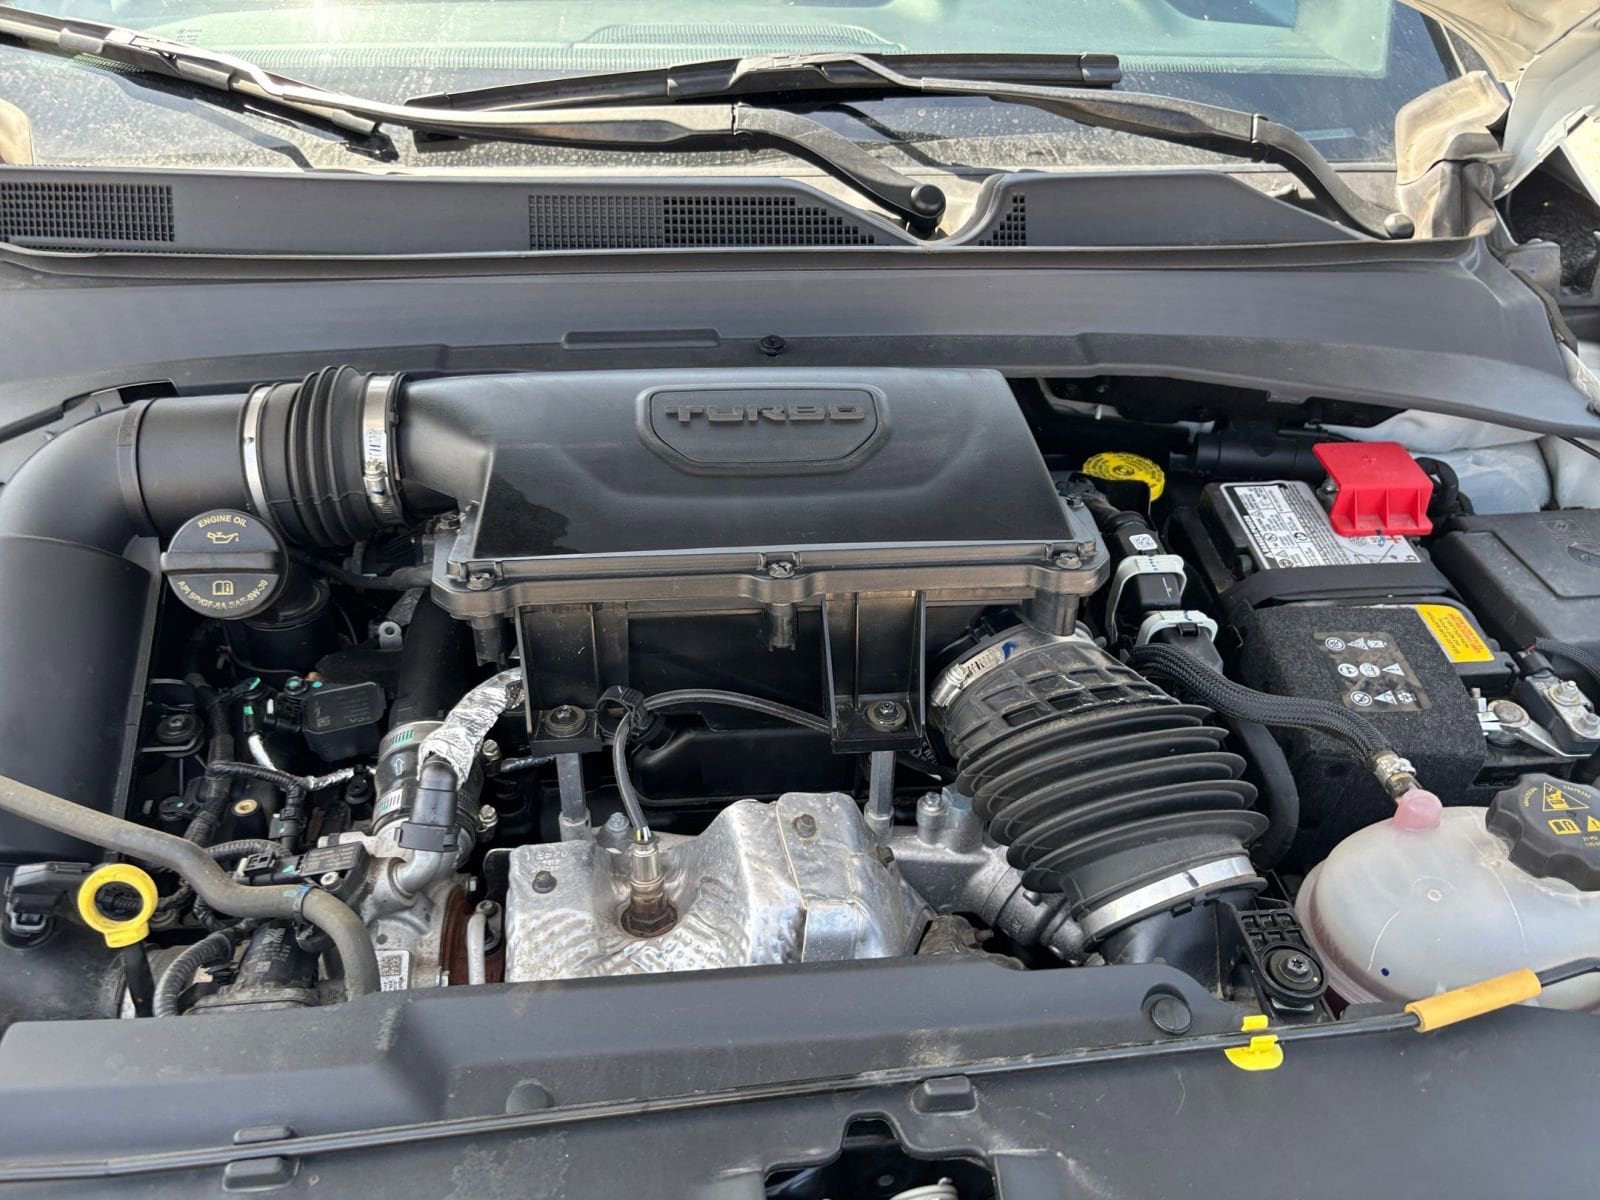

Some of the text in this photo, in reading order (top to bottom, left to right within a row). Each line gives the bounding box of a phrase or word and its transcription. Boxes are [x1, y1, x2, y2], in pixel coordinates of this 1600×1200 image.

[664, 403, 865, 423] TURBO
[197, 514, 248, 529] ENGINE OIL
[176, 580, 191, 594] API
